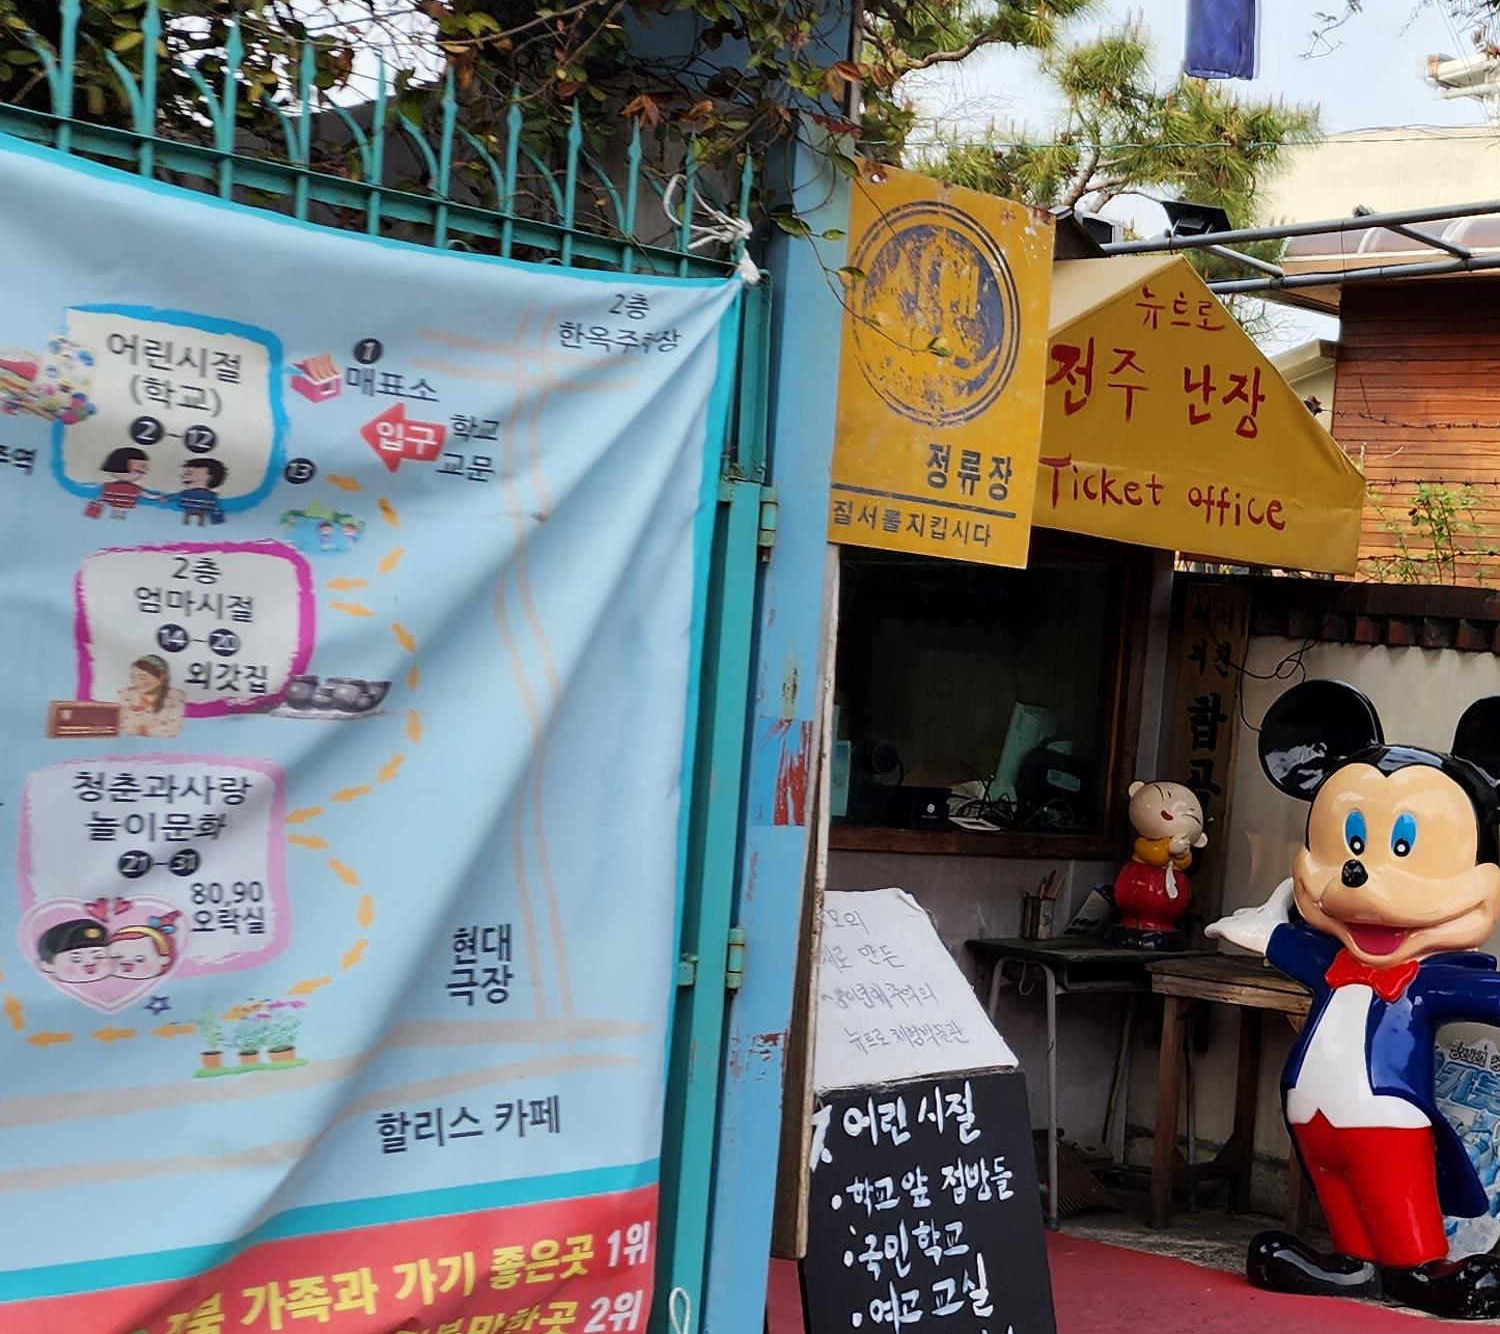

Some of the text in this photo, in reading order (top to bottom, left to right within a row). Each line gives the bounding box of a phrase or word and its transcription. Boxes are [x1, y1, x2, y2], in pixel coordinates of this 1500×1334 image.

[608, 293, 651, 320] 2층
[107, 333, 242, 384] 어린시절
[130, 375, 222, 417] (학교)
[346, 366, 440, 402] 매표소
[1046, 336, 1266, 439] 전주 난장
[376, 420, 439, 456] 입구
[450, 414, 500, 442] 학교
[436, 452, 495, 482] 교문
[926, 443, 1013, 501] 정류장
[1039, 453, 1286, 531] Ticket office
[172, 556, 222, 585] 2층
[135, 586, 254, 623] 엄마시절
[184, 661, 268, 694] 외갓집
[73, 771, 253, 806] 청춘과사랑
[84, 811, 228, 842] 놀이문화
[191, 907, 266, 935] 오락실
[453, 923, 513, 966] 현대
[446, 965, 514, 1006] 극장
[376, 1095, 561, 1154] 할리스 카페
[240, 1267, 379, 1331] 가족과
[393, 1251, 476, 1306] 가기
[607, 1220, 651, 1268] 1위
[583, 1289, 644, 1334] 2위
